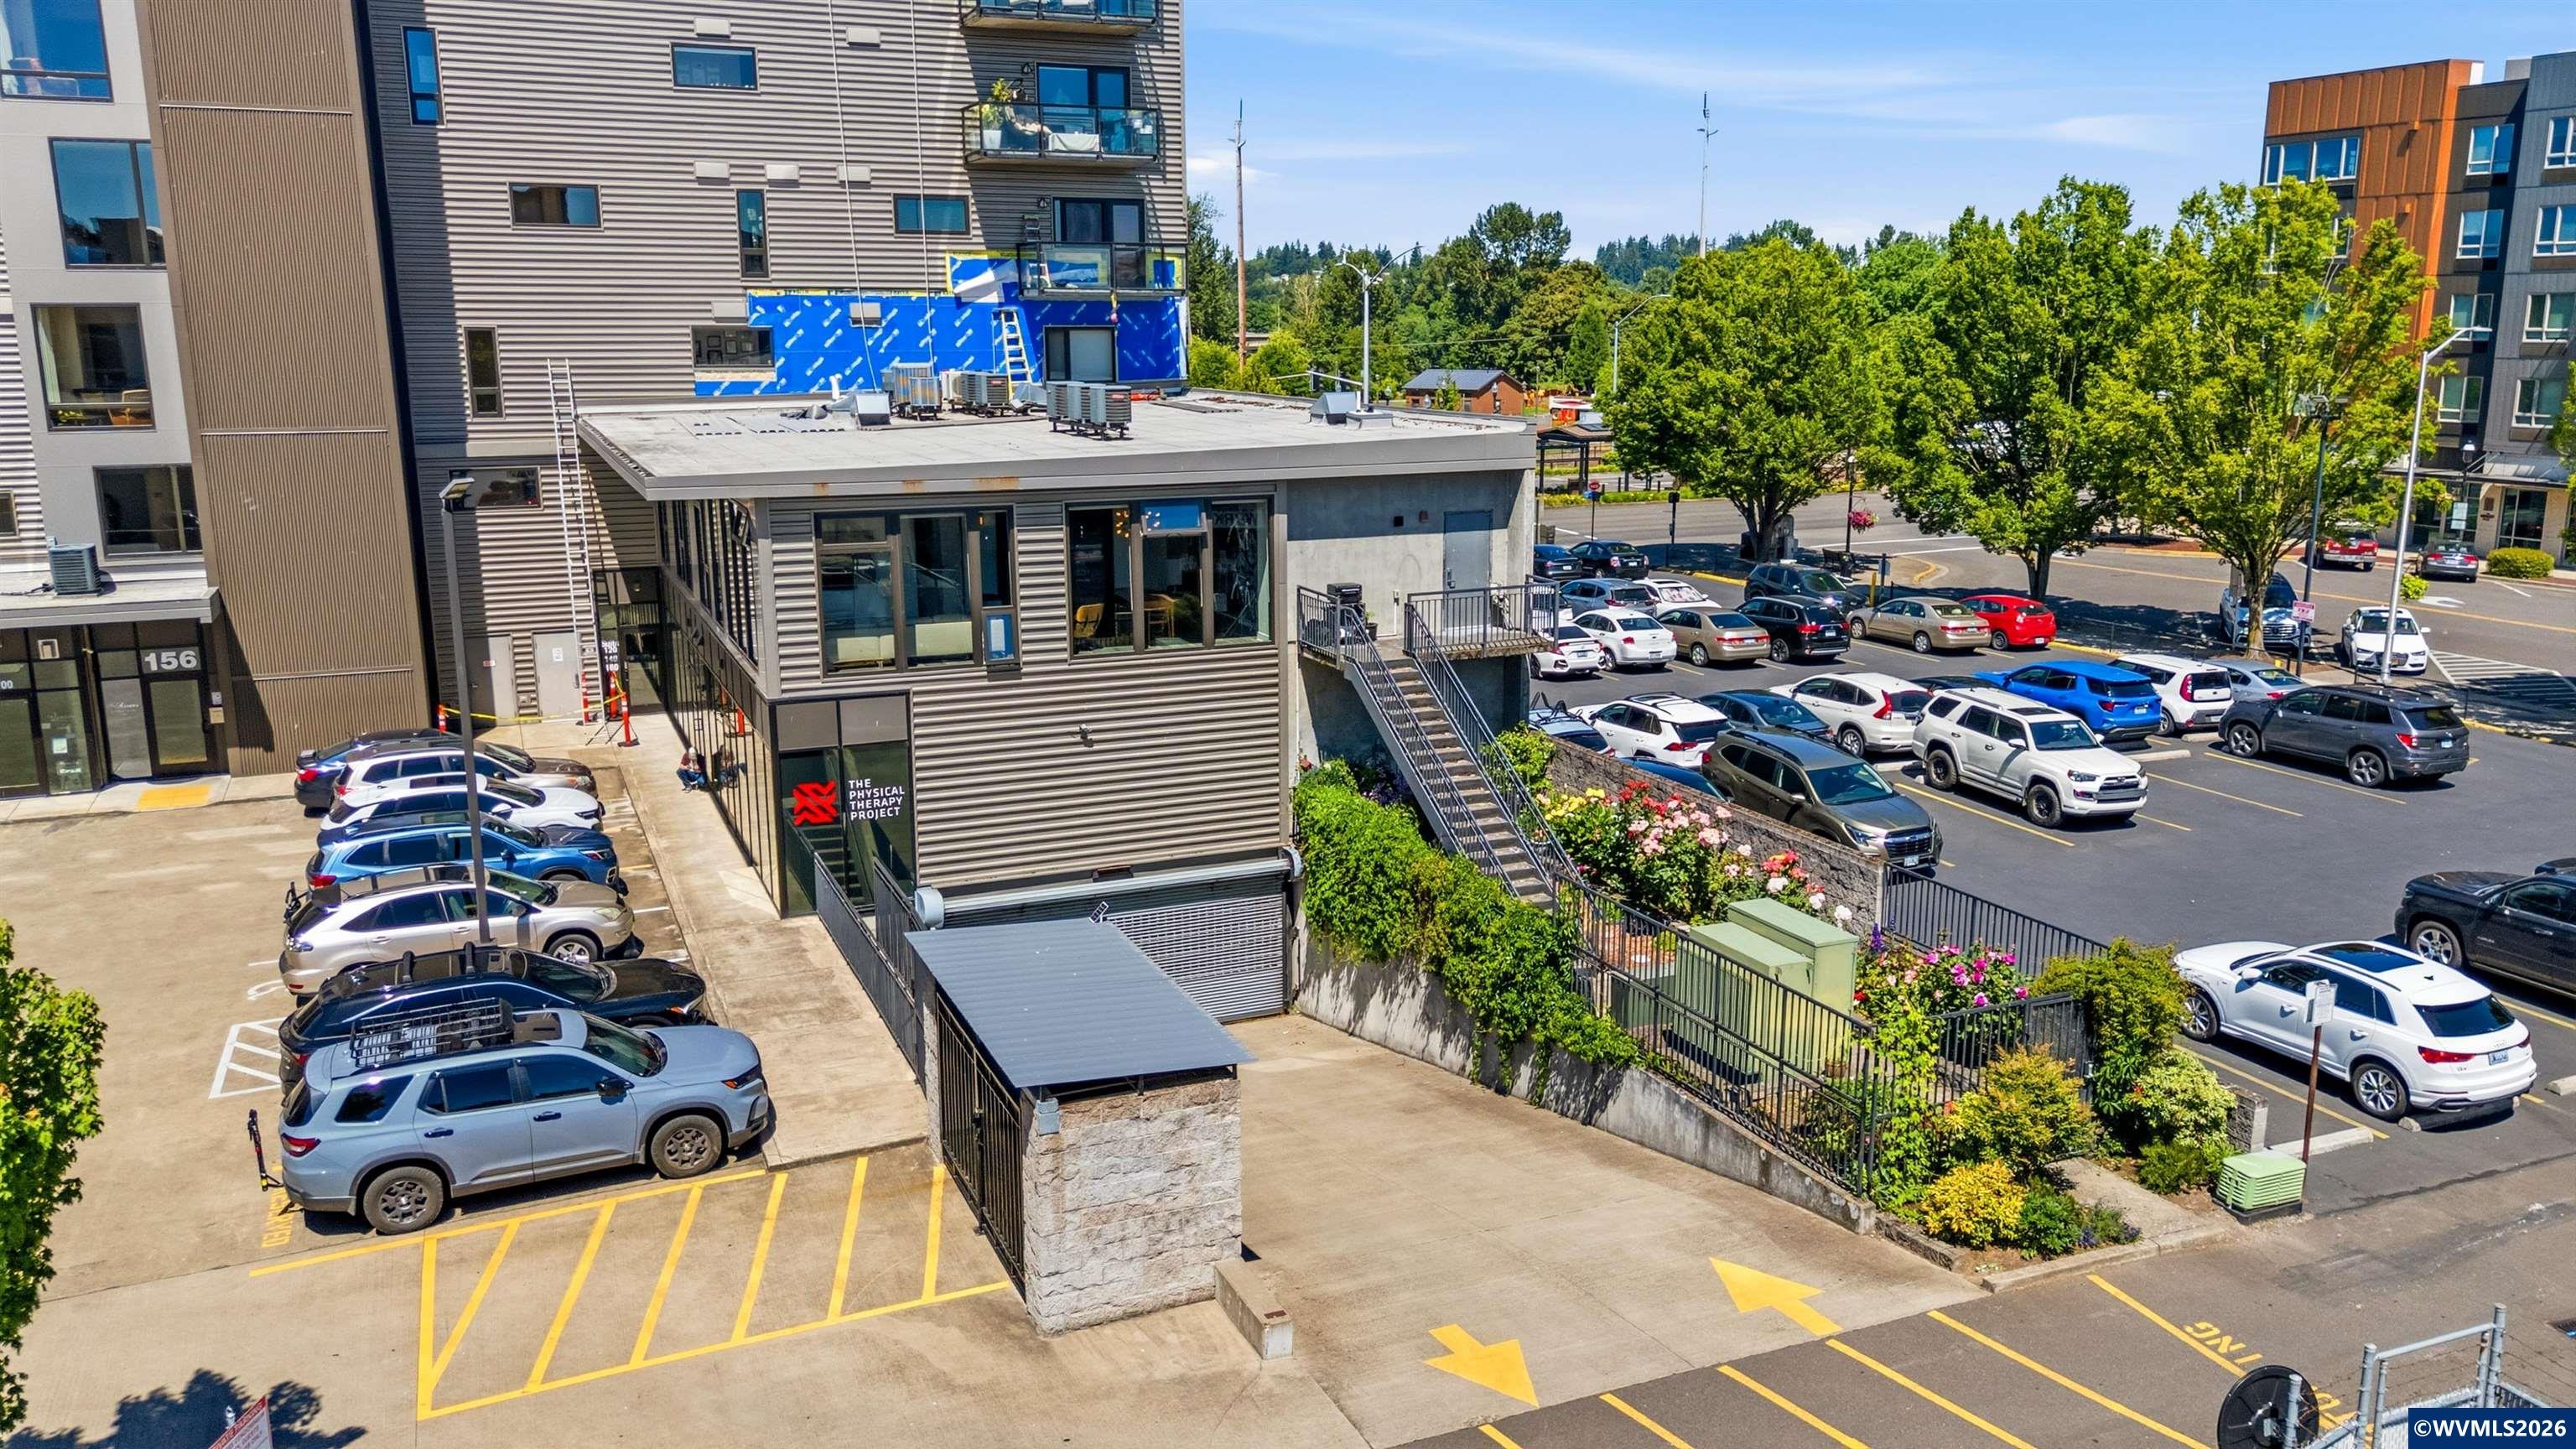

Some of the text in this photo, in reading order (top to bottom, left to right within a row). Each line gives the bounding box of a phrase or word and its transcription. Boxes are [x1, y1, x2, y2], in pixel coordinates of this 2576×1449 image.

[144, 650, 197, 671] 156
[0, 680, 13, 689] 00
[848, 778, 871, 789] THE
[849, 786, 905, 800] PHYSICAL
[849, 797, 903, 810] THERAPY
[850, 807, 901, 821] PROJECT
